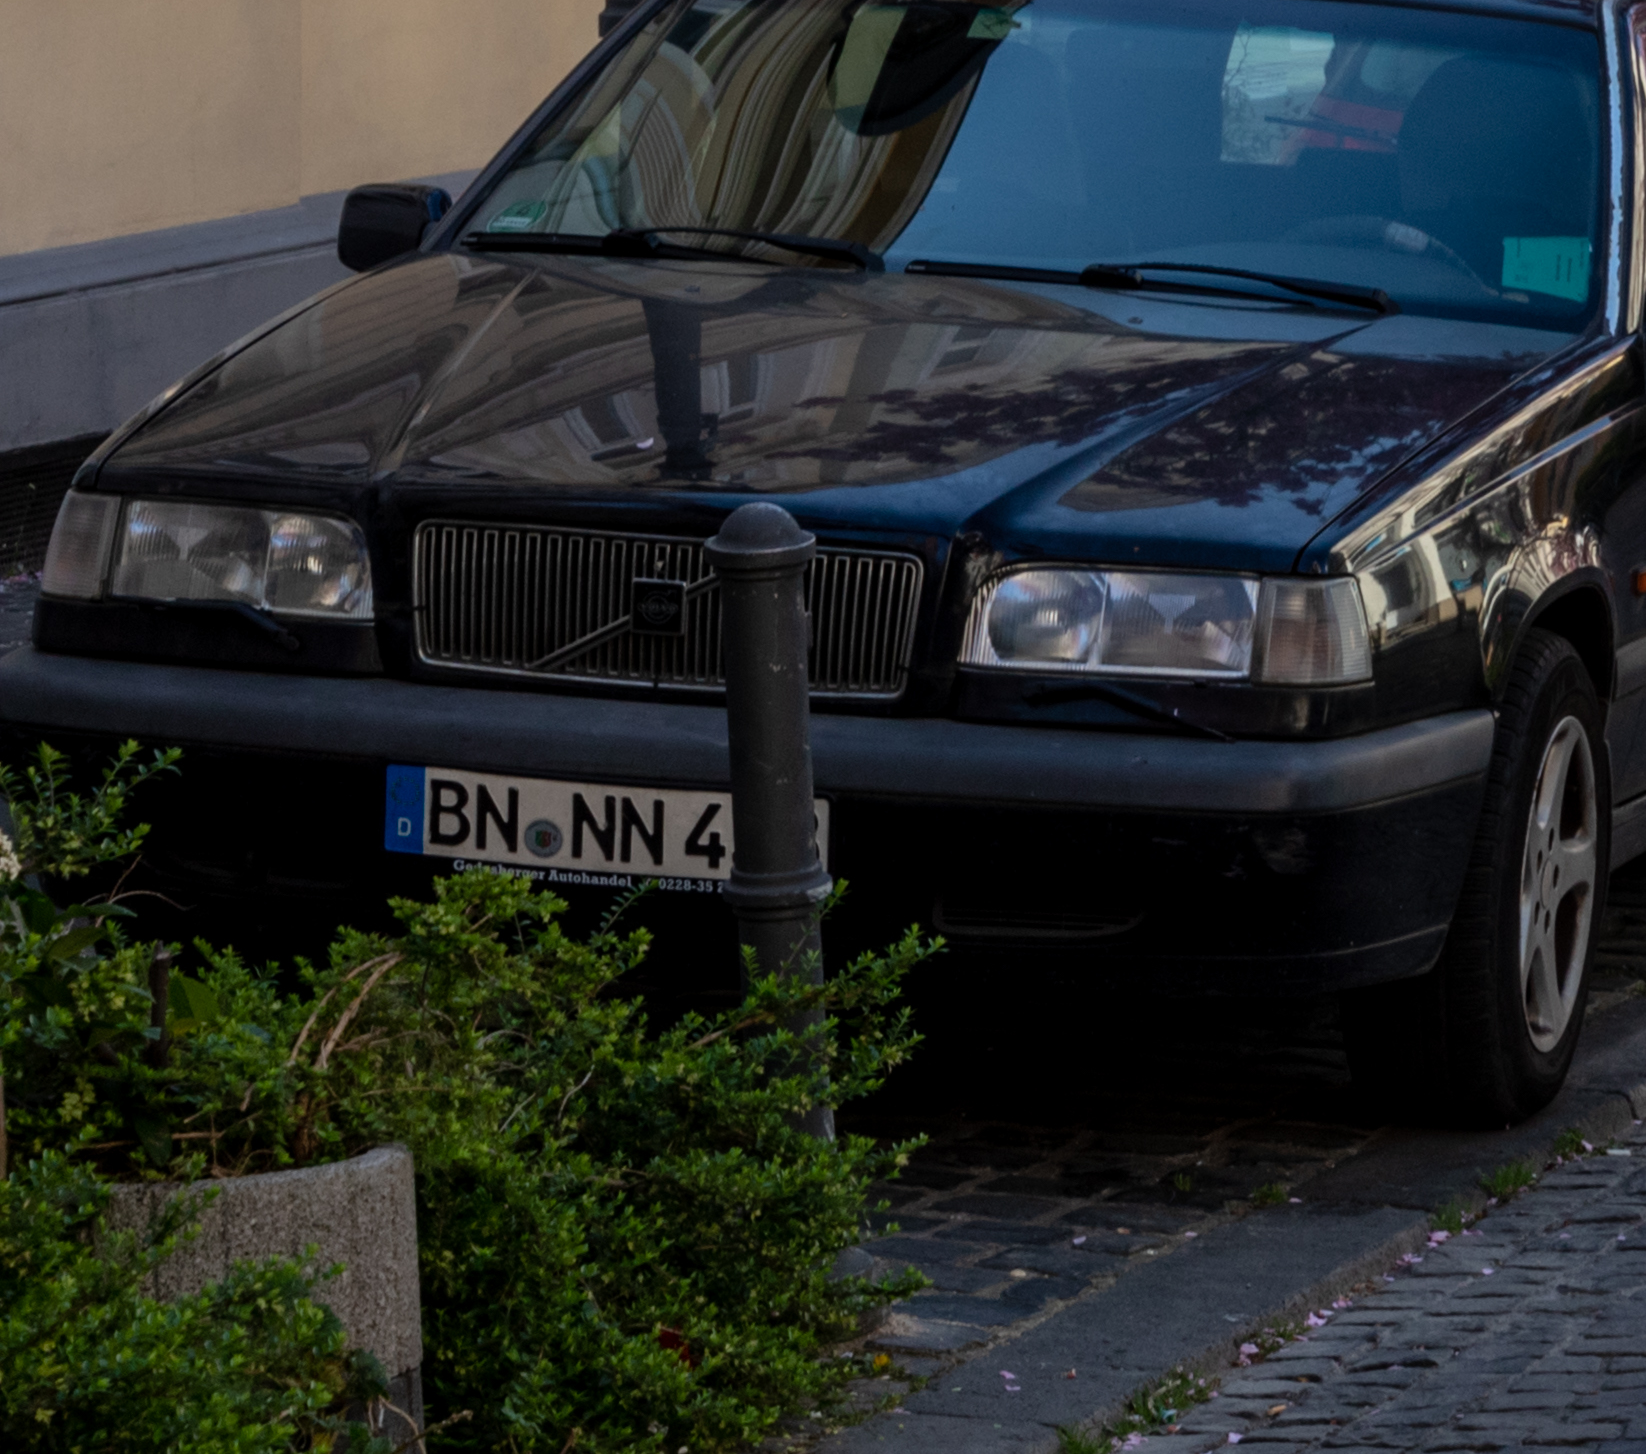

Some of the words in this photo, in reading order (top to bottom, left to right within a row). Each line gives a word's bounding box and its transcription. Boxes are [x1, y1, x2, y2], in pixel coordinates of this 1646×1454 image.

[397, 817, 412, 837] D
[429, 778, 519, 854] BN
[571, 792, 665, 866] NN
[547, 869, 632, 888] Autohandel
[658, 877, 713, 893] 0228-35
